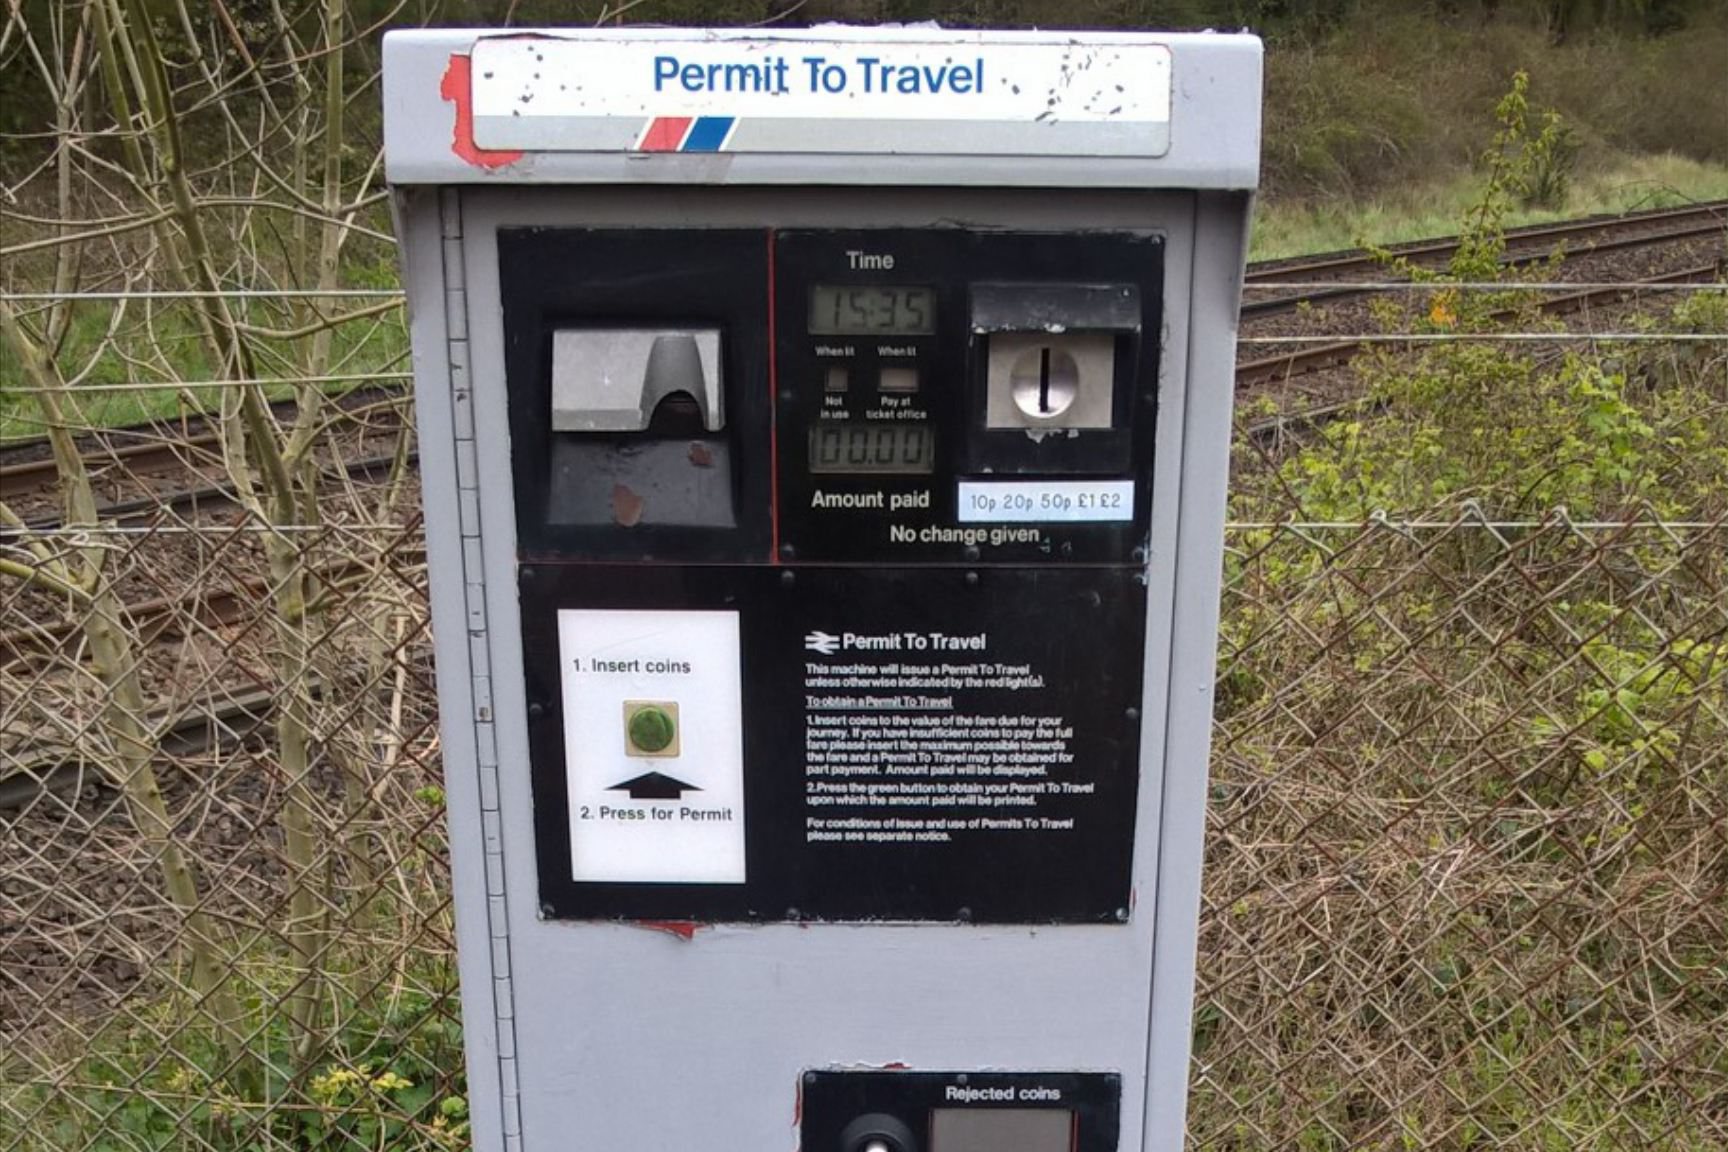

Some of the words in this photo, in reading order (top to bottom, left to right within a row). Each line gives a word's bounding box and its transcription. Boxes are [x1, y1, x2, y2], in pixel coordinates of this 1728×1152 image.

[654, 56, 789, 93] Permit
[803, 57, 847, 93] To
[856, 57, 983, 94] Travel
[846, 251, 895, 270] Time
[815, 346, 844, 357] When
[845, 346, 855, 357] lit
[878, 346, 906, 357] When
[907, 346, 917, 357] lit
[825, 396, 842, 406] Not
[881, 396, 898, 407] Pay
[901, 397, 911, 406] at
[820, 409, 830, 419] in
[832, 411, 850, 419] use
[866, 409, 895, 420] ticket
[896, 409, 927, 420] office
[811, 490, 884, 508] Amount
[890, 490, 930, 511] paid
[971, 494, 997, 513] 10p
[1003, 494, 1034, 512] 20p
[1040, 493, 1072, 512] 50p
[1077, 493, 1096, 509] £1
[1100, 492, 1121, 509] £2
[890, 525, 917, 543] No
[919, 525, 988, 546] change
[990, 525, 1040, 547] given
[842, 632, 902, 650] Permit
[903, 632, 928, 650] To
[928, 632, 986, 651] Travel
[573, 658, 587, 673] 1.
[591, 658, 640, 673] Insert
[645, 660, 692, 674] coins
[805, 664, 829, 674] This
[830, 664, 877, 674] machine
[880, 664, 899, 674] will
[901, 664, 930, 674] issue
[941, 664, 978, 674] Permit
[980, 664, 994, 674] To
[995, 664, 1030, 674] Travel
[805, 677, 840, 688] unless
[842, 677, 897, 688] otherwise
[898, 677, 948, 688] indicated
[951, 677, 963, 689] by
[965, 677, 983, 688] the
[985, 677, 1004, 688] red
[806, 696, 820, 708] To
[823, 696, 855, 708] obtain
[858, 699, 865, 707] a
[866, 696, 900, 708] Permit
[902, 696, 917, 708] To
[918, 696, 953, 708] Travel
[848, 715, 878, 726] coins
[880, 715, 891, 726] to
[892, 715, 910, 726] the
[911, 715, 940, 726] value
[942, 715, 954, 726] of
[955, 715, 973, 726] the
[975, 715, 996, 726] fare
[998, 715, 1018, 726] due
[1020, 715, 1037, 726] for
[1038, 717, 1062, 727] your
[852, 728, 860, 738] If
[860, 730, 880, 740] you
[883, 728, 908, 738] have
[909, 728, 969, 738] insufficient
[970, 728, 1000, 738] coins
[1002, 728, 1013, 738] to
[1013, 730, 1035, 740] pay
[1036, 728, 1054, 738] the
[1055, 728, 1073, 738] full
[807, 740, 828, 751] fare
[830, 740, 865, 753] please
[867, 740, 898, 751] insert
[900, 740, 918, 751] the
[920, 740, 972, 751] maximum
[974, 740, 1020, 752] possible
[1021, 740, 1065, 751] towards
[807, 752, 824, 763] the
[826, 752, 848, 763] fare
[849, 752, 870, 763] and
[872, 755, 878, 763] a
[880, 752, 916, 763] Permit
[917, 752, 931, 763] To
[932, 752, 967, 763] Travel
[968, 754, 991, 765] may
[992, 752, 1007, 763] be
[1008, 752, 1056, 763] obtained
[1058, 752, 1074, 763] for
[806, 764, 830, 776] part
[885, 764, 929, 775] Amount
[930, 764, 955, 776] paid
[956, 764, 976, 775] will
[977, 764, 992, 775] be
[849, 782, 866, 793] the
[867, 784, 899, 795] green
[900, 782, 936, 793] button
[938, 782, 948, 793] to
[949, 782, 983, 793] obtain
[984, 784, 1008, 795] your
[1009, 782, 1045, 793] Permit
[1046, 782, 1060, 793] To
[1061, 782, 1095, 793] Travel
[807, 797, 834, 806] upon
[836, 795, 868, 805] which
[869, 795, 887, 805] the
[888, 795, 929, 805] amount
[932, 795, 956, 807] paid
[957, 795, 976, 805] will
[977, 795, 992, 805] be
[580, 807, 594, 820] 2.
[600, 807, 645, 820] Press
[651, 807, 674, 820] for
[680, 808, 733, 822] Permit
[807, 818, 825, 829] For
[826, 818, 881, 829] conditions
[883, 818, 895, 829] of
[896, 818, 923, 829] issue
[926, 818, 946, 829] and
[947, 820, 966, 829] use
[968, 818, 980, 829] of
[981, 818, 1023, 829] Permits
[1024, 818, 1039, 829] To
[1040, 818, 1074, 829] Travel
[807, 831, 842, 842] please
[845, 833, 865, 841] see
[866, 831, 914, 842] separate
[946, 1086, 1014, 1103] Rejected
[1019, 1086, 1061, 1101] coins
